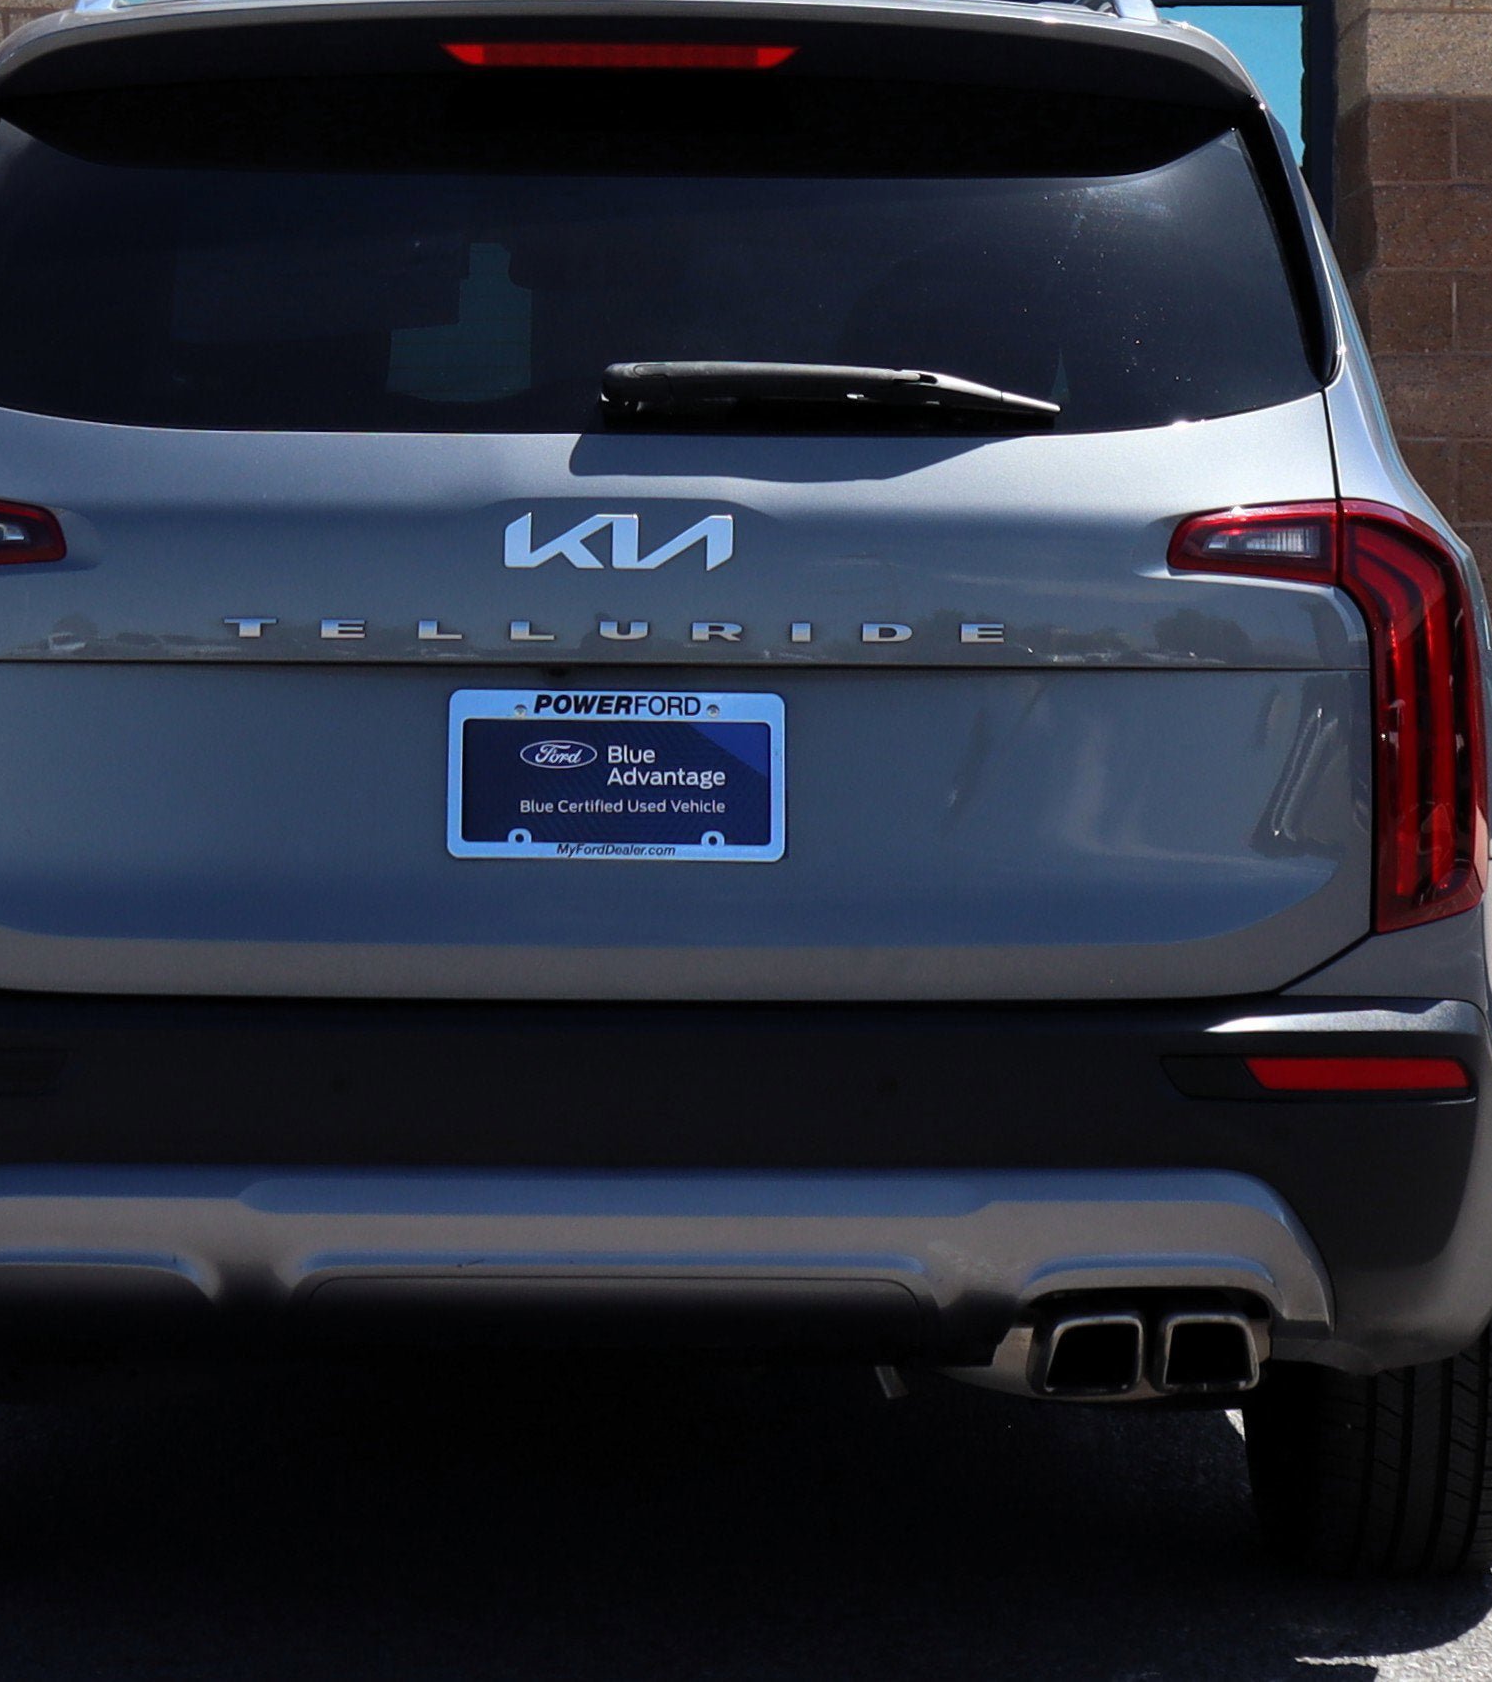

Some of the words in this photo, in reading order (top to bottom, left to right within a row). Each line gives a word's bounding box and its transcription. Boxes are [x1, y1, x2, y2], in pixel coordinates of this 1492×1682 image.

[504, 512, 734, 571] KIA
[223, 616, 1006, 645] TELLURIDE
[533, 694, 701, 716] POWERFORD
[534, 743, 583, 765] Ford
[607, 744, 656, 764] Blue
[606, 767, 726, 790] Advantage
[519, 799, 554, 814] Blue
[557, 799, 623, 814] Certified
[627, 799, 666, 814] Used
[670, 799, 726, 814] Vehicle
[556, 843, 676, 858] MyFordDealer.com
